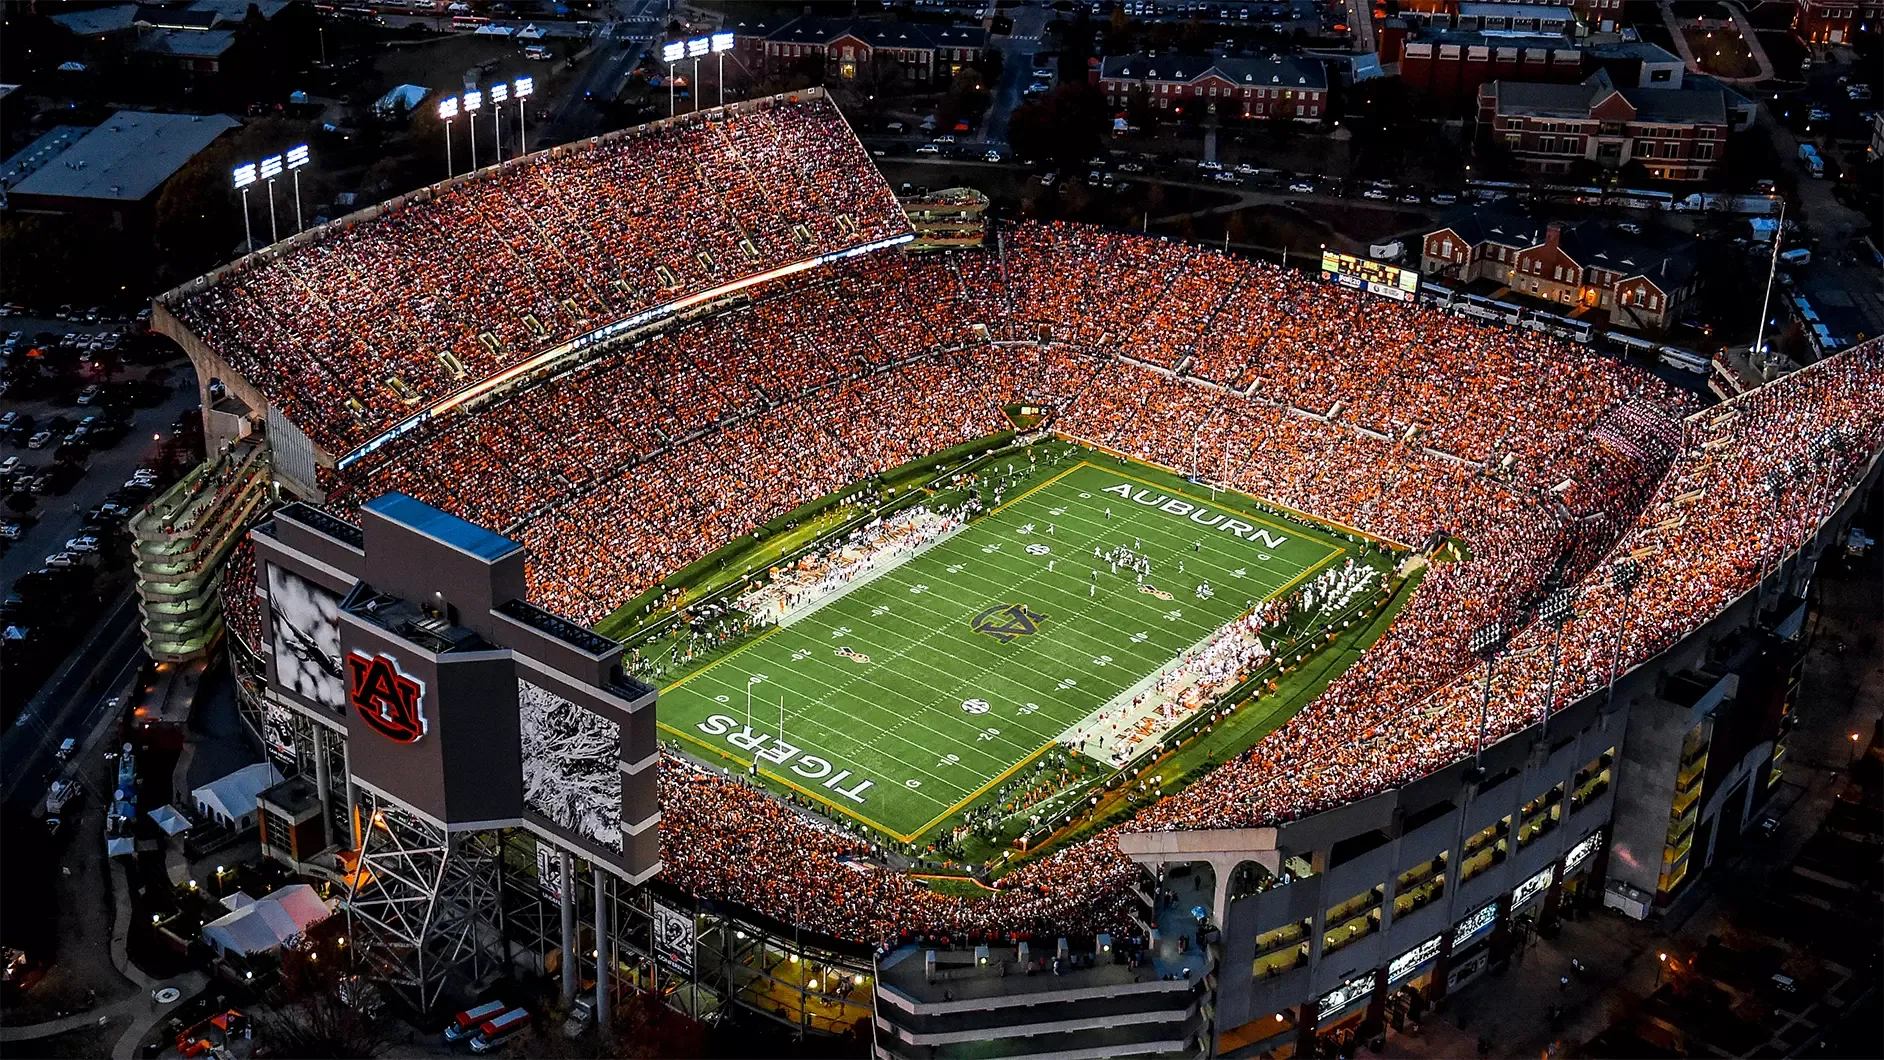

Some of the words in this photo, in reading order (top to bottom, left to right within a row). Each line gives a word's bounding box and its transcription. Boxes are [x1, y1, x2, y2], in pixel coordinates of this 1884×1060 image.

[1101, 483, 1288, 549] AUBURN
[979, 728, 1001, 741] 20
[696, 713, 875, 804] TIGERS
[940, 754, 960, 766] 10
[905, 779, 922, 788] G
[657, 910, 687, 954] 12
[657, 954, 691, 976] CONFERENCE
